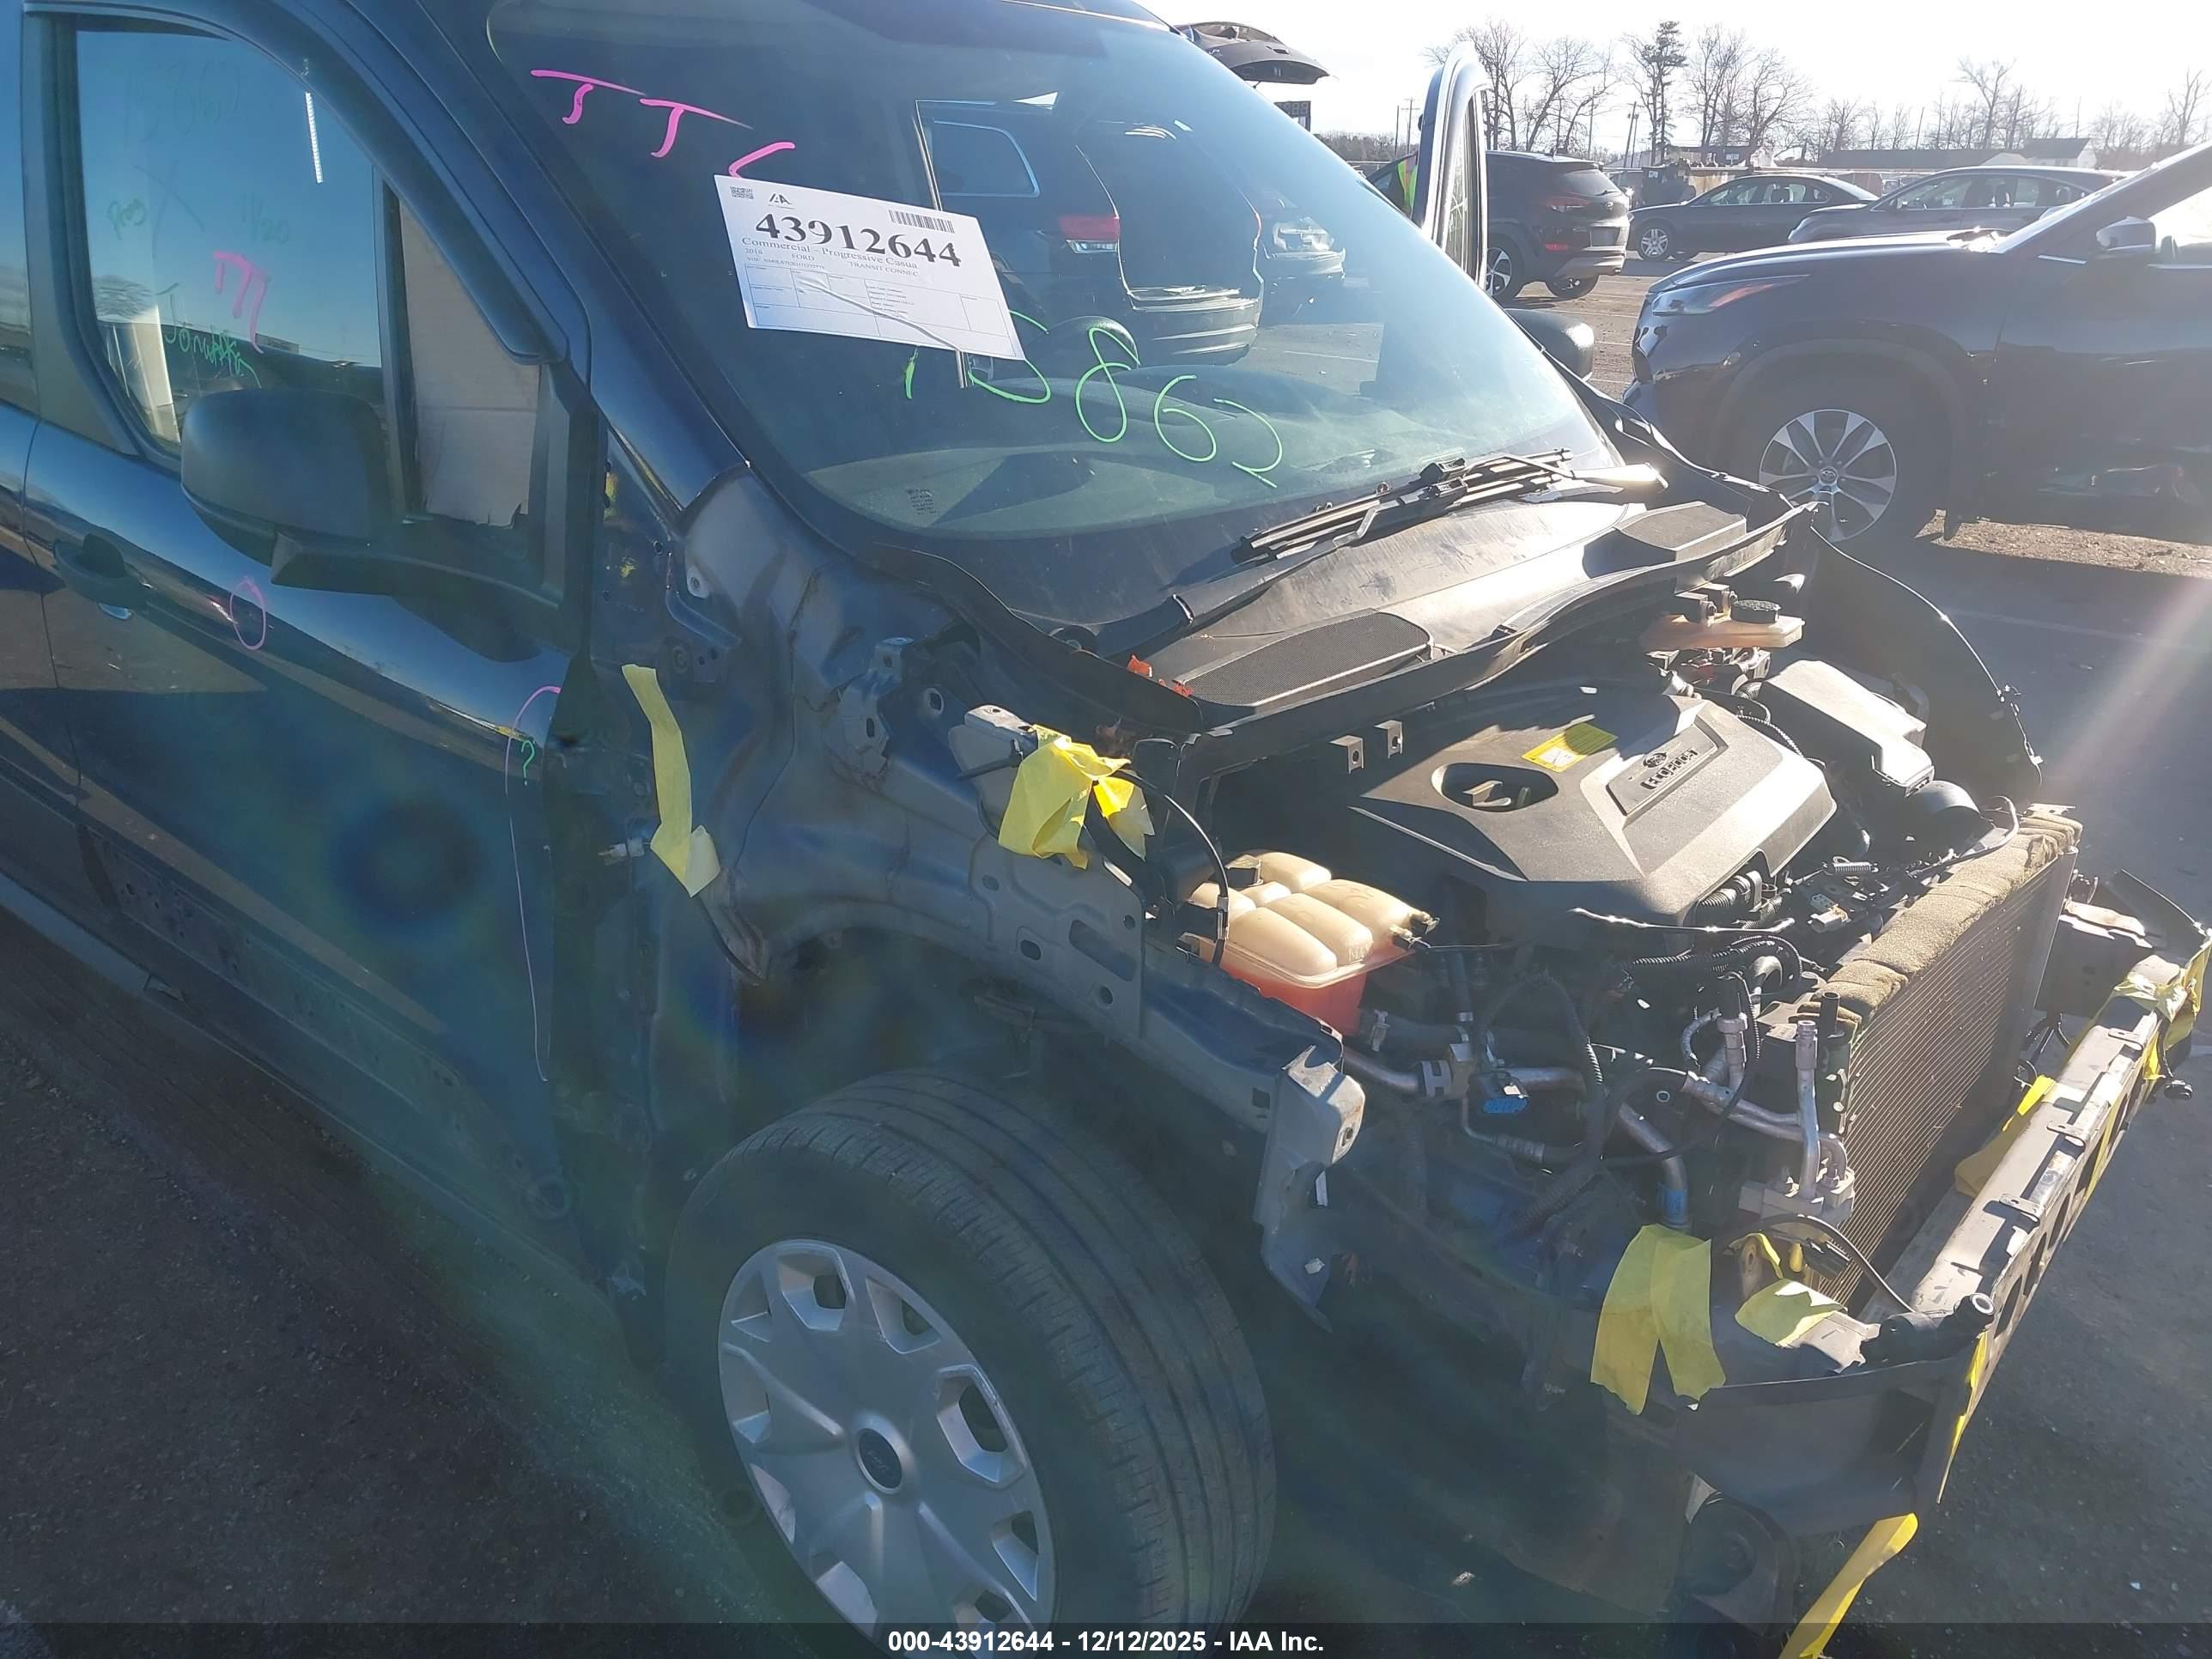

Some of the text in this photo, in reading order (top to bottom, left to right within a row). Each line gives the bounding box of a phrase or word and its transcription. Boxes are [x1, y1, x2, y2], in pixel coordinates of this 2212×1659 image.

[742, 237, 811, 252] Commercial
[822, 247, 883, 264] Progressive
[885, 257, 918, 269] Casua
[756, 213, 962, 268] 43912644
[849, 261, 884, 271] TRANSIT
